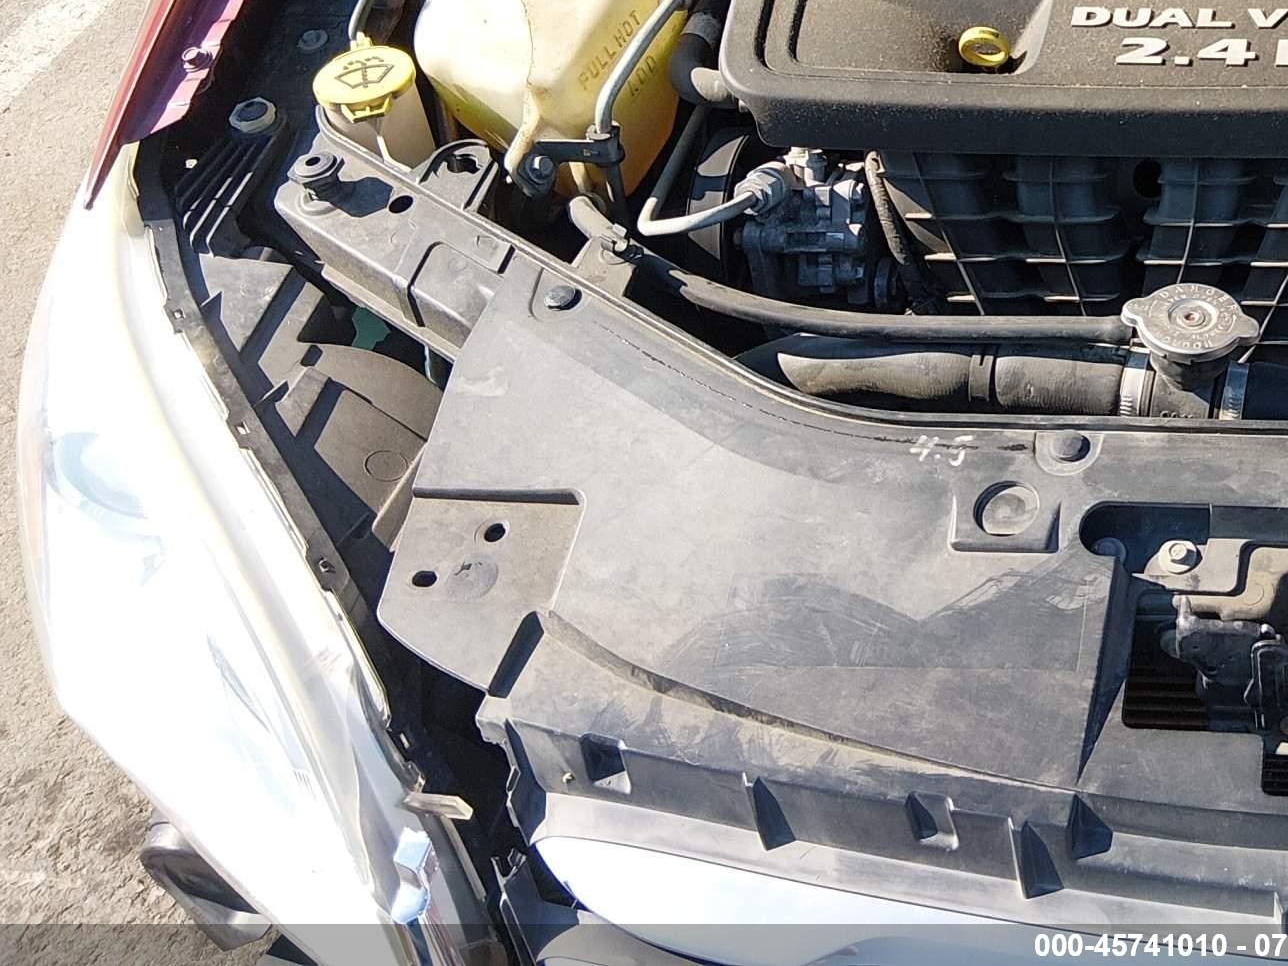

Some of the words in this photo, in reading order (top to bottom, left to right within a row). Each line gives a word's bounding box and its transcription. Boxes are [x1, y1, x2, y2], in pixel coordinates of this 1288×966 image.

[1070, 5, 1235, 29] DUAL
[578, 45, 617, 91] FULL
[613, 9, 641, 48] HOT
[1114, 37, 1259, 67] 2.4
